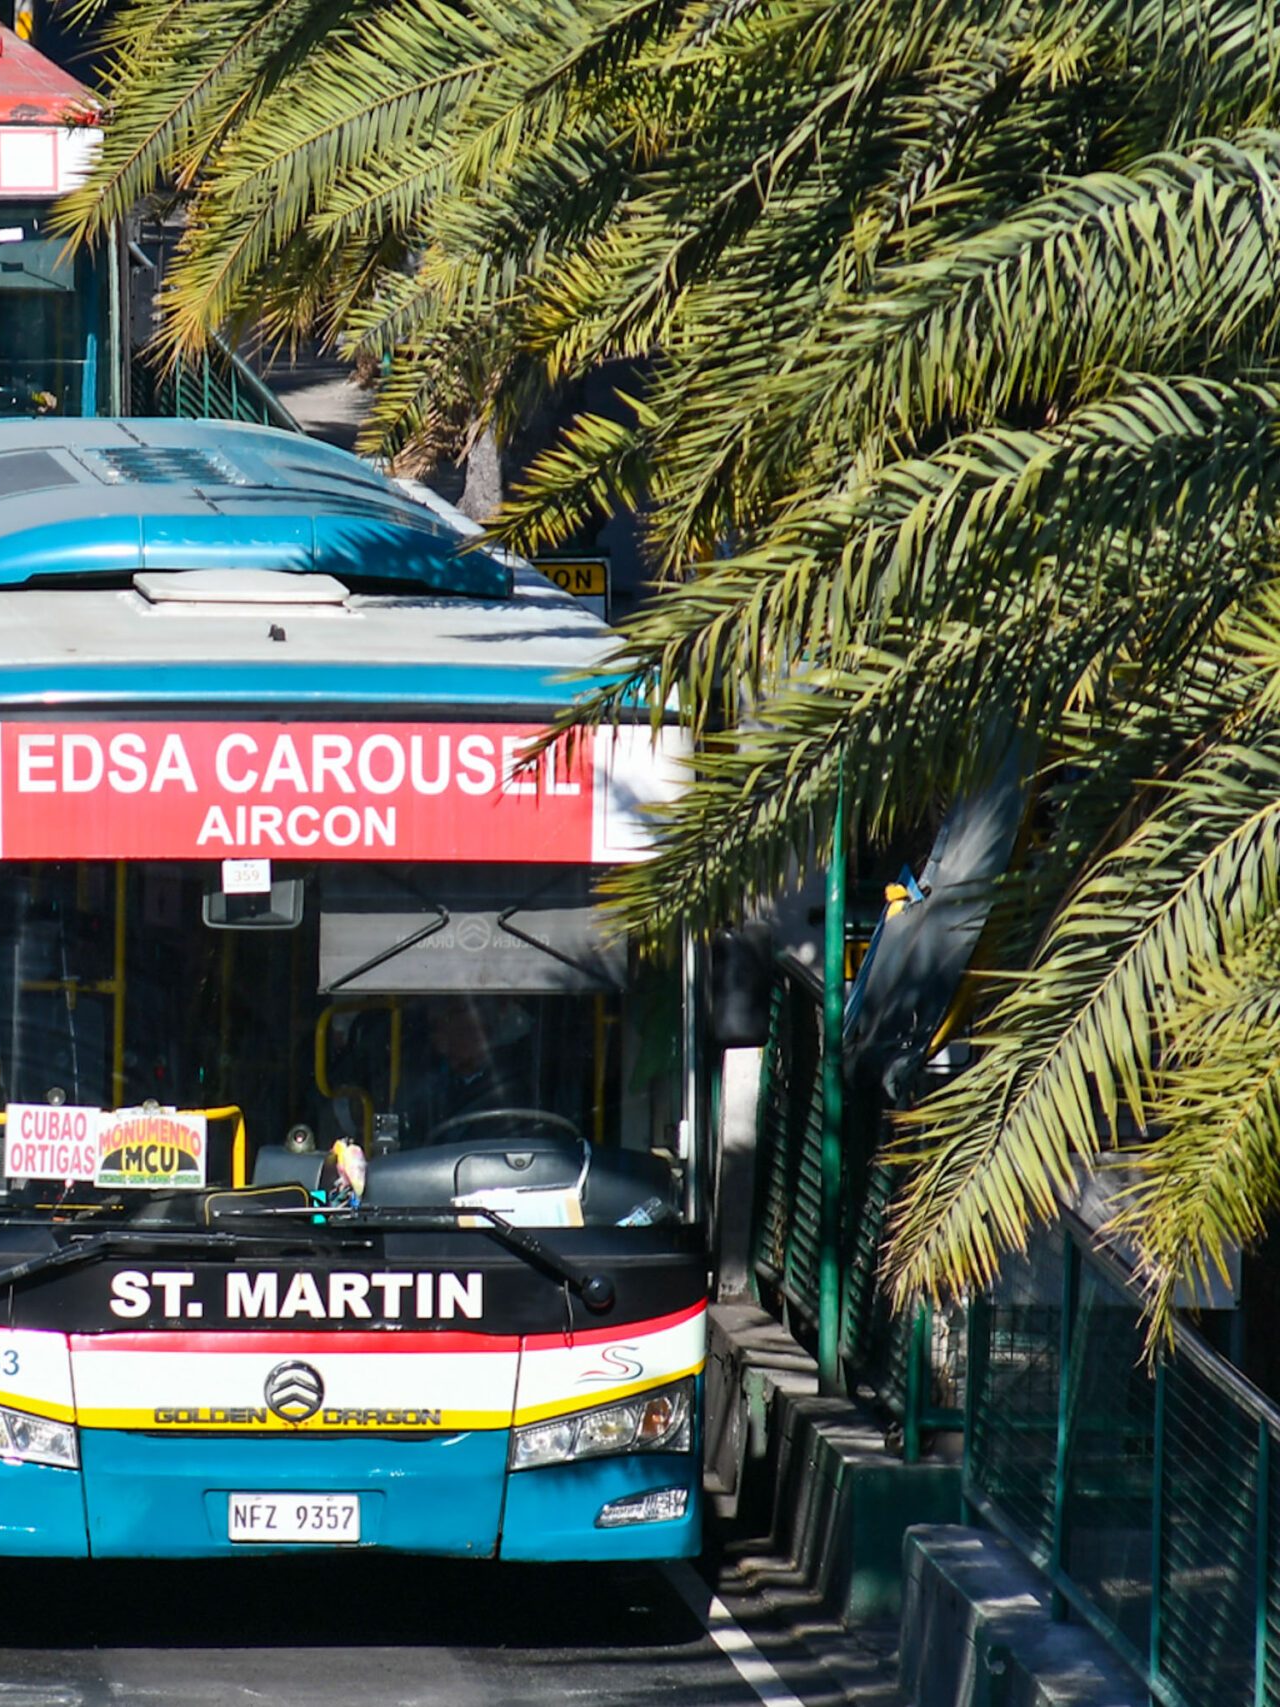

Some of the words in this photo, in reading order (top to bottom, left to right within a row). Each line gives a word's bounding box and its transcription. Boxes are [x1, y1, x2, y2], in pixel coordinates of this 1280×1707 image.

[543, 569, 592, 590] ON
[17, 732, 199, 794] EDSA
[215, 732, 580, 796] CAROUSEL
[196, 804, 396, 847] AIRCON
[21, 1110, 88, 1141] CUBAO
[98, 1117, 202, 1158] MONUMENTO
[10, 1143, 95, 1175] ORTIGAS
[124, 1144, 178, 1174] MCU
[109, 1270, 204, 1319] ST.
[225, 1271, 484, 1320] MARTIN
[154, 1407, 268, 1425] GOLDEN
[322, 1408, 442, 1426] DRAGON
[233, 1504, 278, 1530] NFZ
[296, 1504, 355, 1531] 9357
